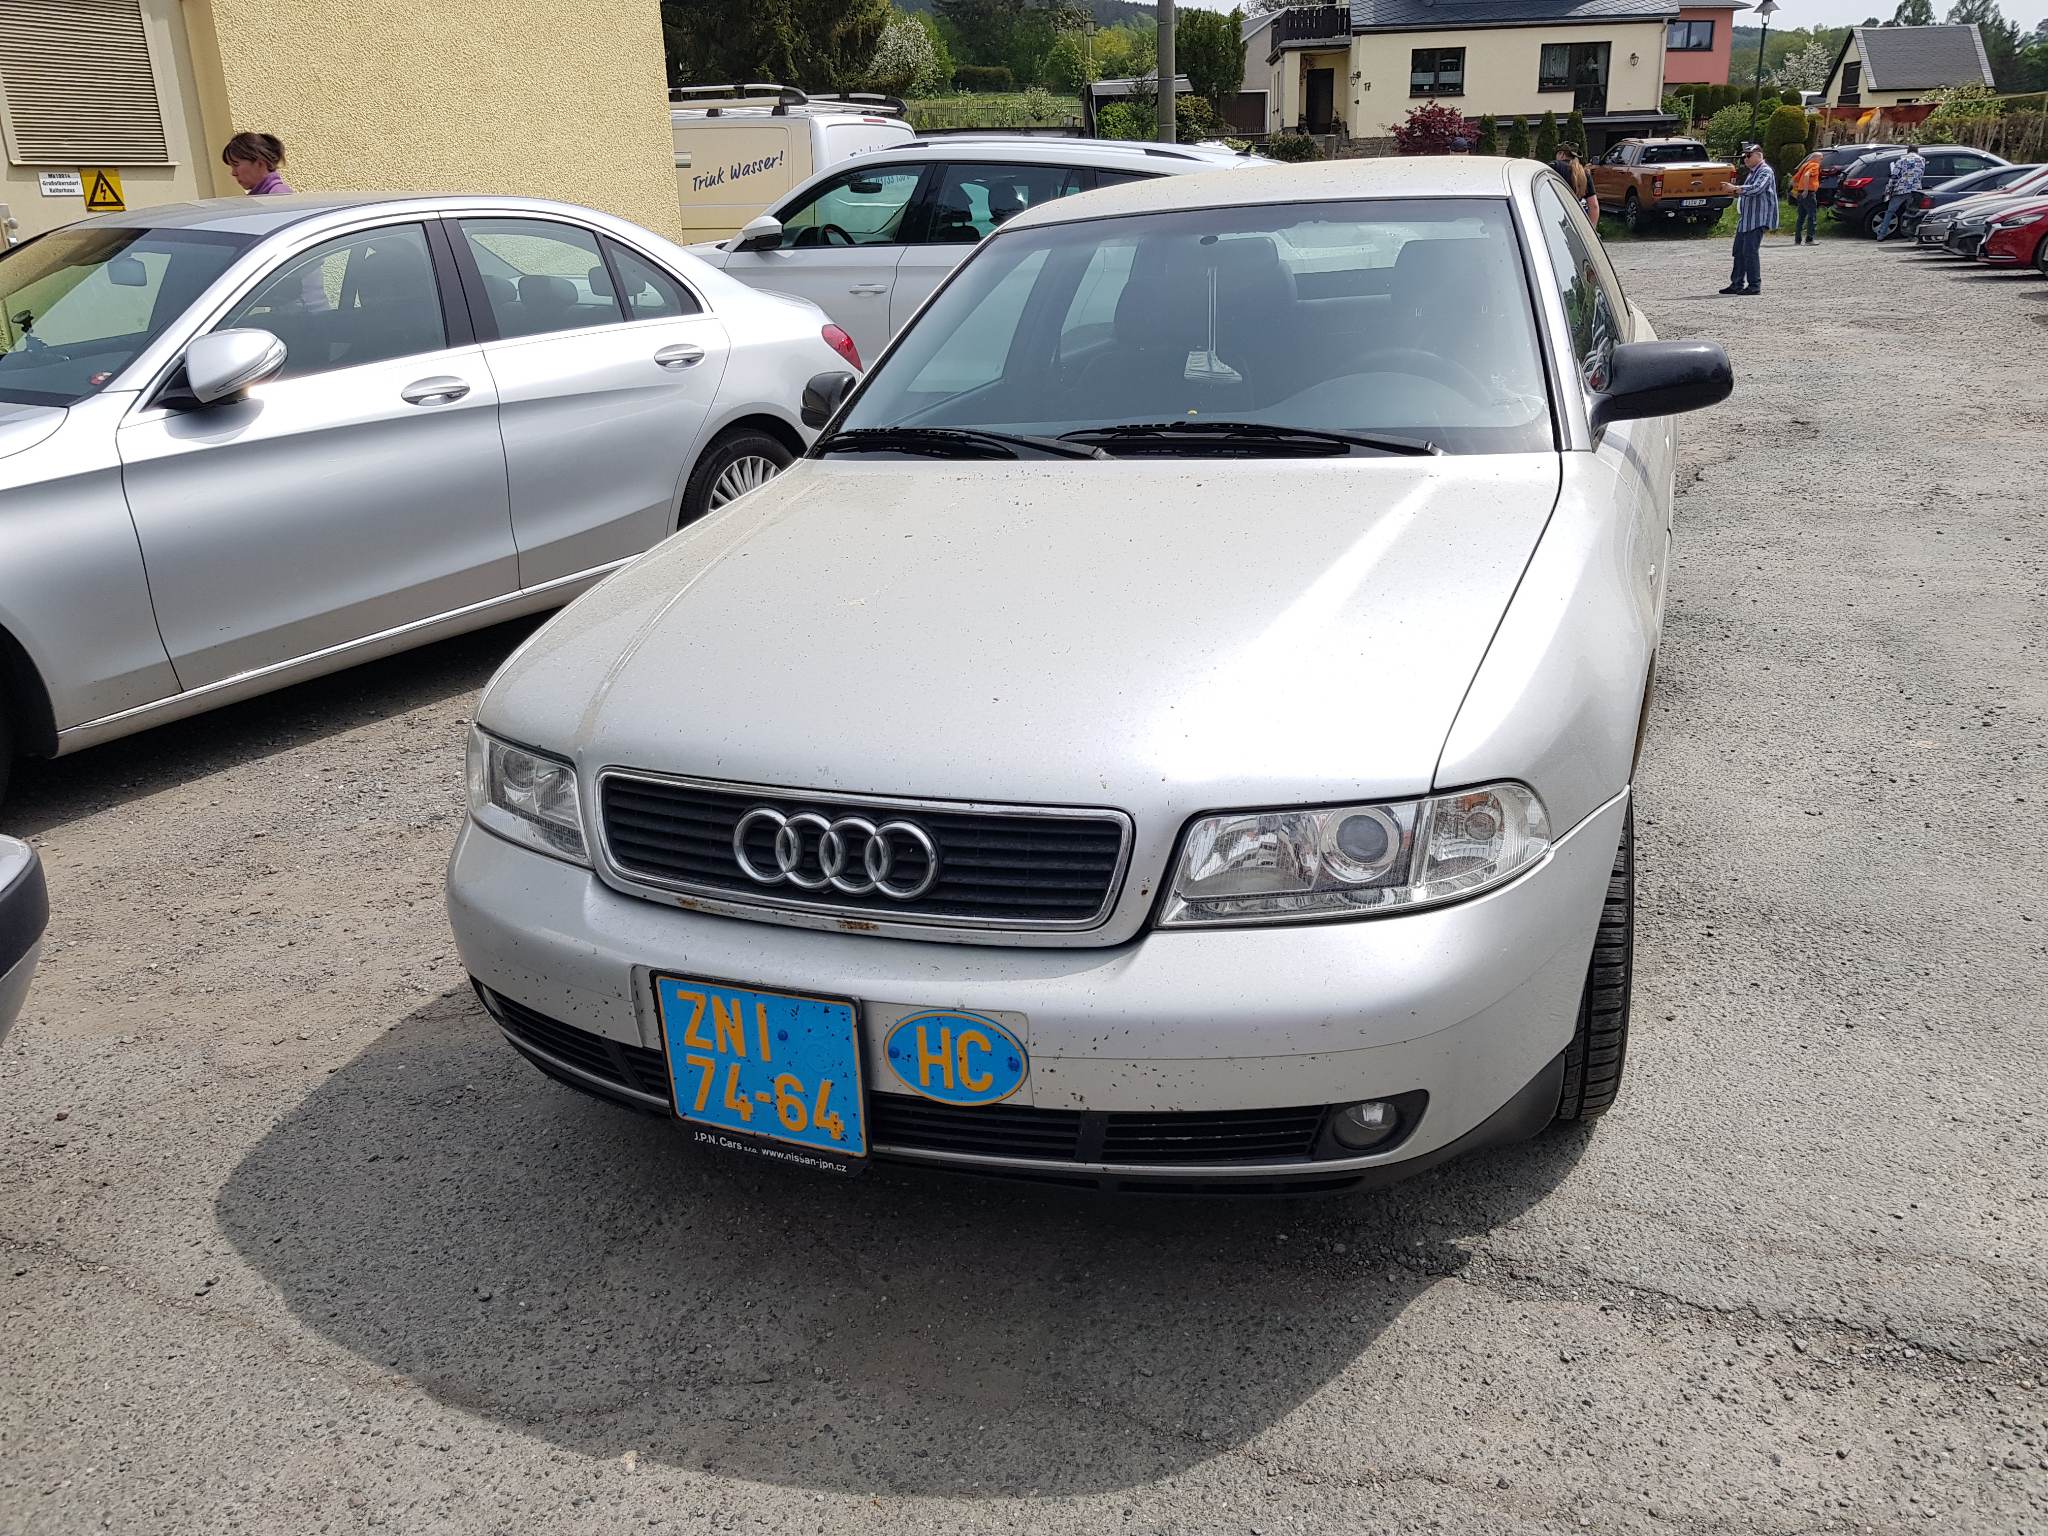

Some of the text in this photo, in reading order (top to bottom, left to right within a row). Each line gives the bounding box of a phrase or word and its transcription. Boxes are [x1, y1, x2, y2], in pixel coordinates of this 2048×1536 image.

[730, 150, 784, 181] Wasser!
[916, 1026, 993, 1092] HC
[686, 1054, 845, 1140] 74-64
[694, 1131, 719, 1145] J.P.N.
[720, 1136, 743, 1151] Cars
[761, 1148, 848, 1173] www.nissan-jpn.cz
